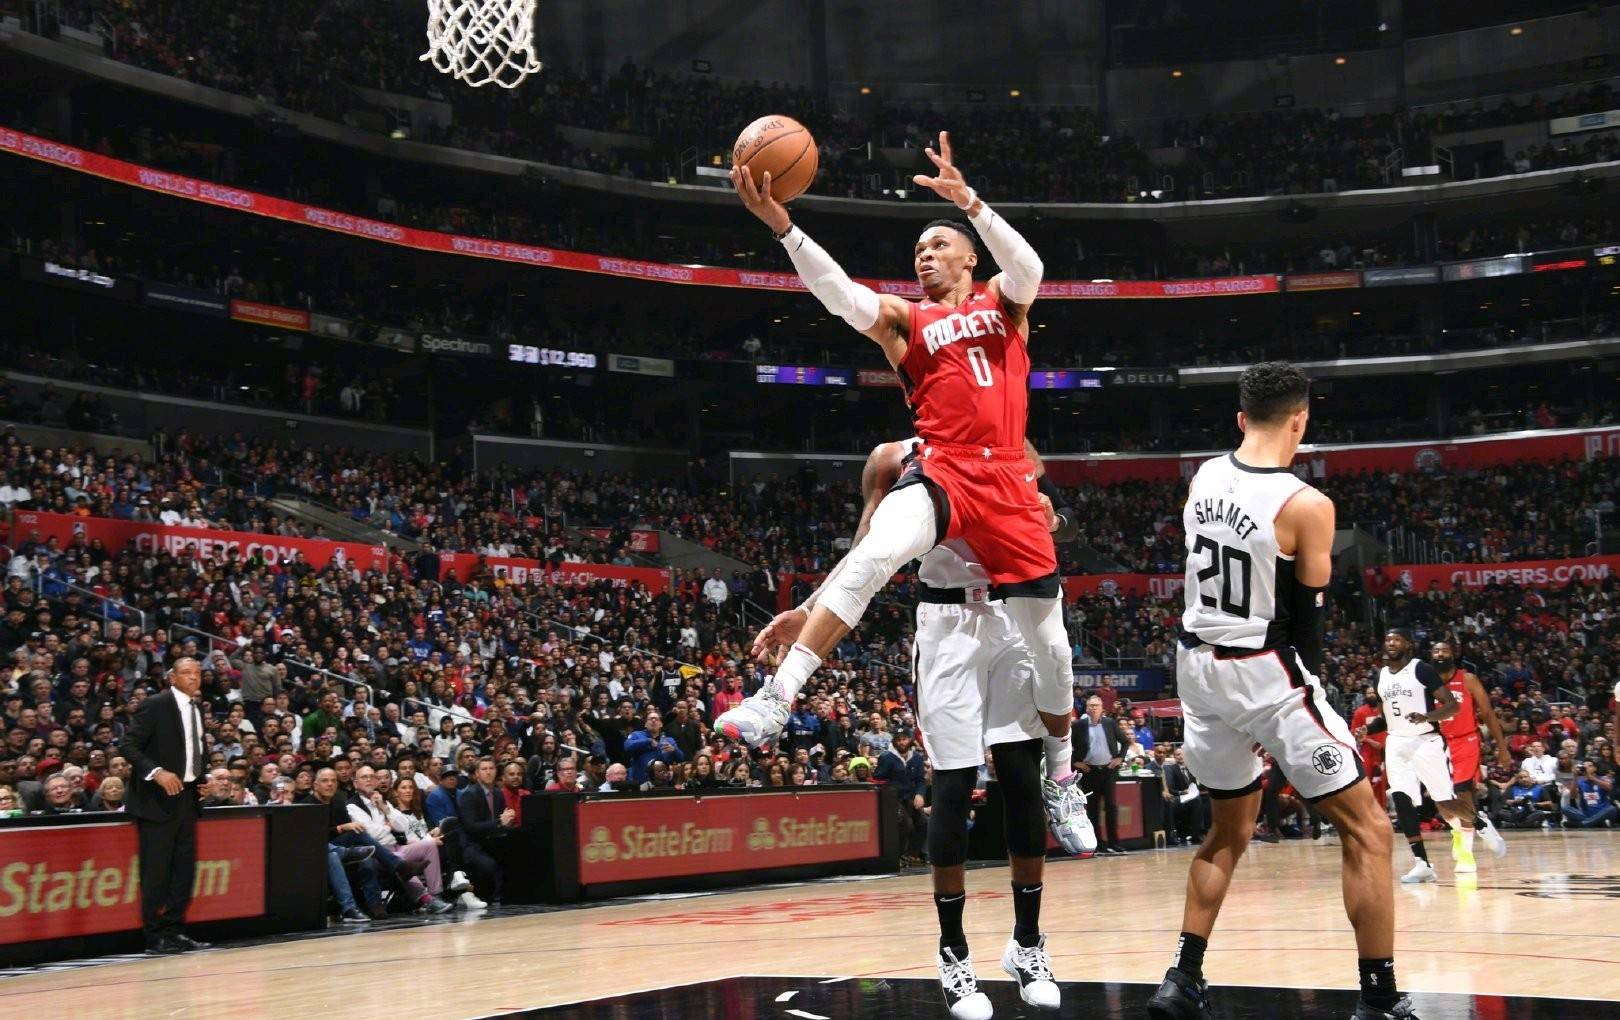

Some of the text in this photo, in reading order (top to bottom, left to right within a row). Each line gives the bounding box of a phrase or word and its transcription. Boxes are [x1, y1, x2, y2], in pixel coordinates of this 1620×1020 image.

[138, 169, 195, 195] WELLS
[304, 206, 352, 228] WELLS
[453, 237, 552, 263] WELLS FARGO
[599, 258, 643, 275] WELLS
[1162, 279, 1264, 295] WELLS FARGO
[420, 333, 491, 354] Spectrum
[966, 345, 994, 387] 0
[1127, 374, 1175, 384] DELTA
[1195, 499, 1258, 541] SHAMET
[1192, 533, 1252, 619] 20
[1451, 564, 1609, 586] CLIPPERS.COM
[1391, 701, 1402, 717] 5
